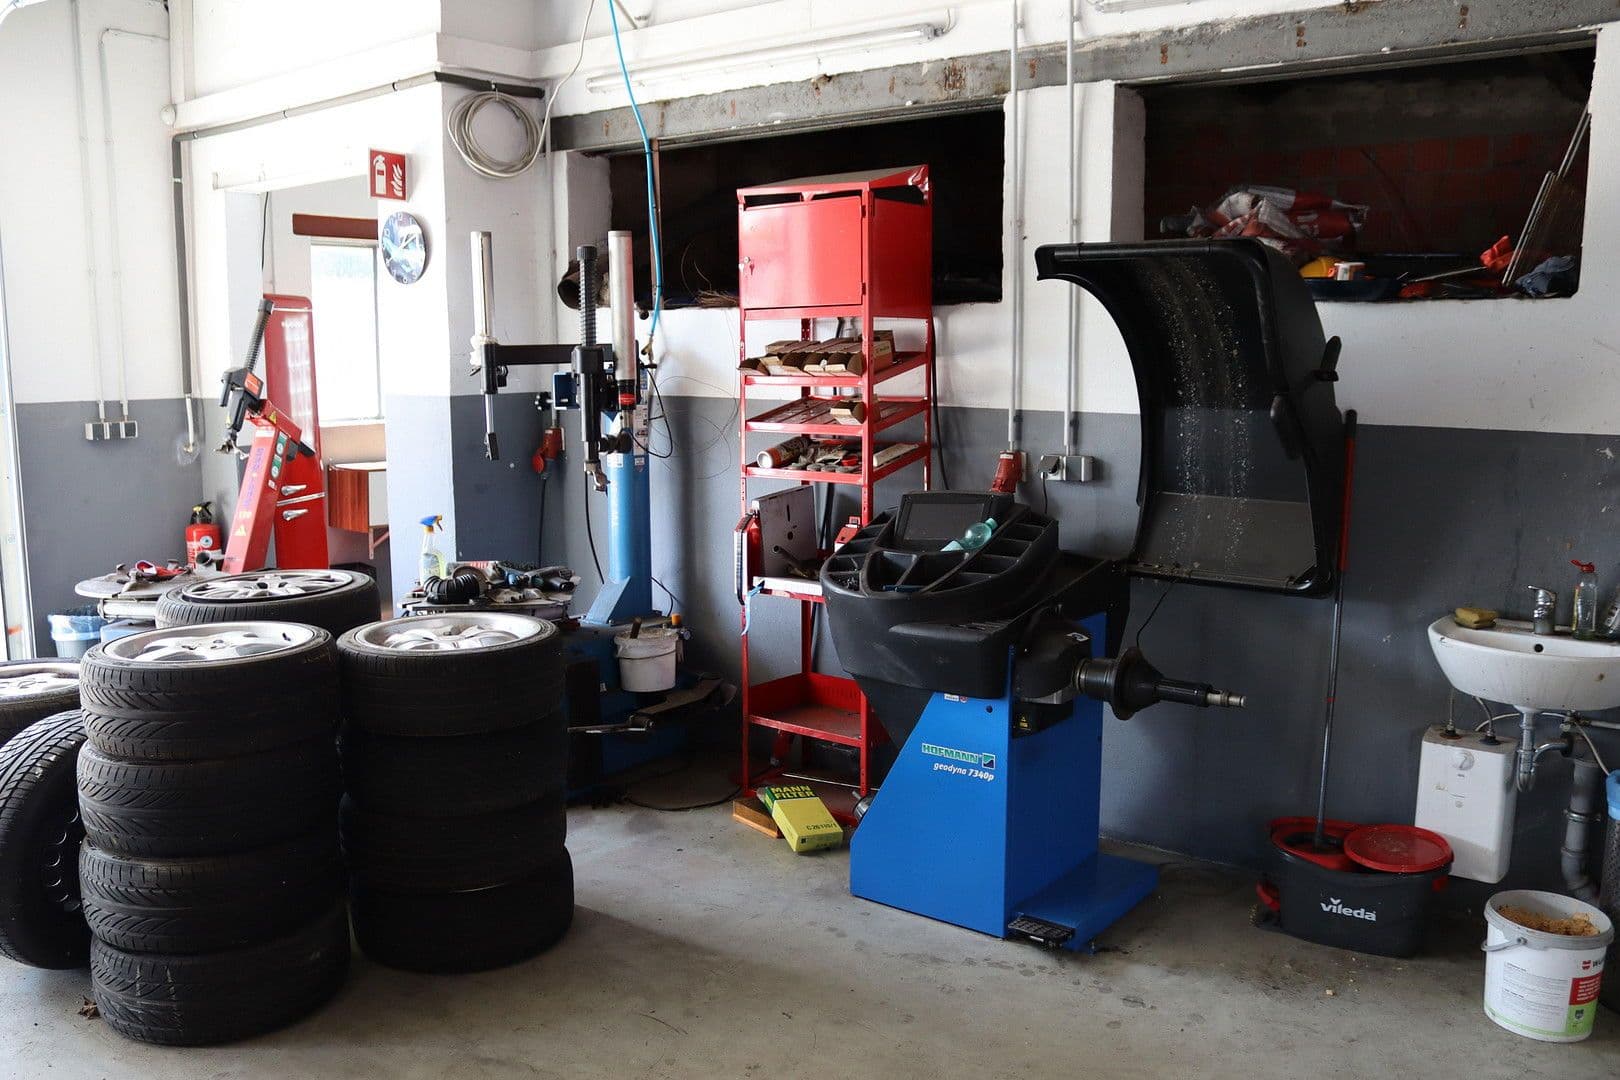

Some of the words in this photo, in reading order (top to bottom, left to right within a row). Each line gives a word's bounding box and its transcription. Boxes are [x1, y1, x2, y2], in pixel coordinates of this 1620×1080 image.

[921, 743, 979, 764] HOFMANN
[933, 762, 967, 775] geodyna
[968, 768, 995, 782] 7340p
[770, 785, 812, 793] MANN
[775, 791, 816, 799] FILTER
[1320, 897, 1376, 921] vileda
